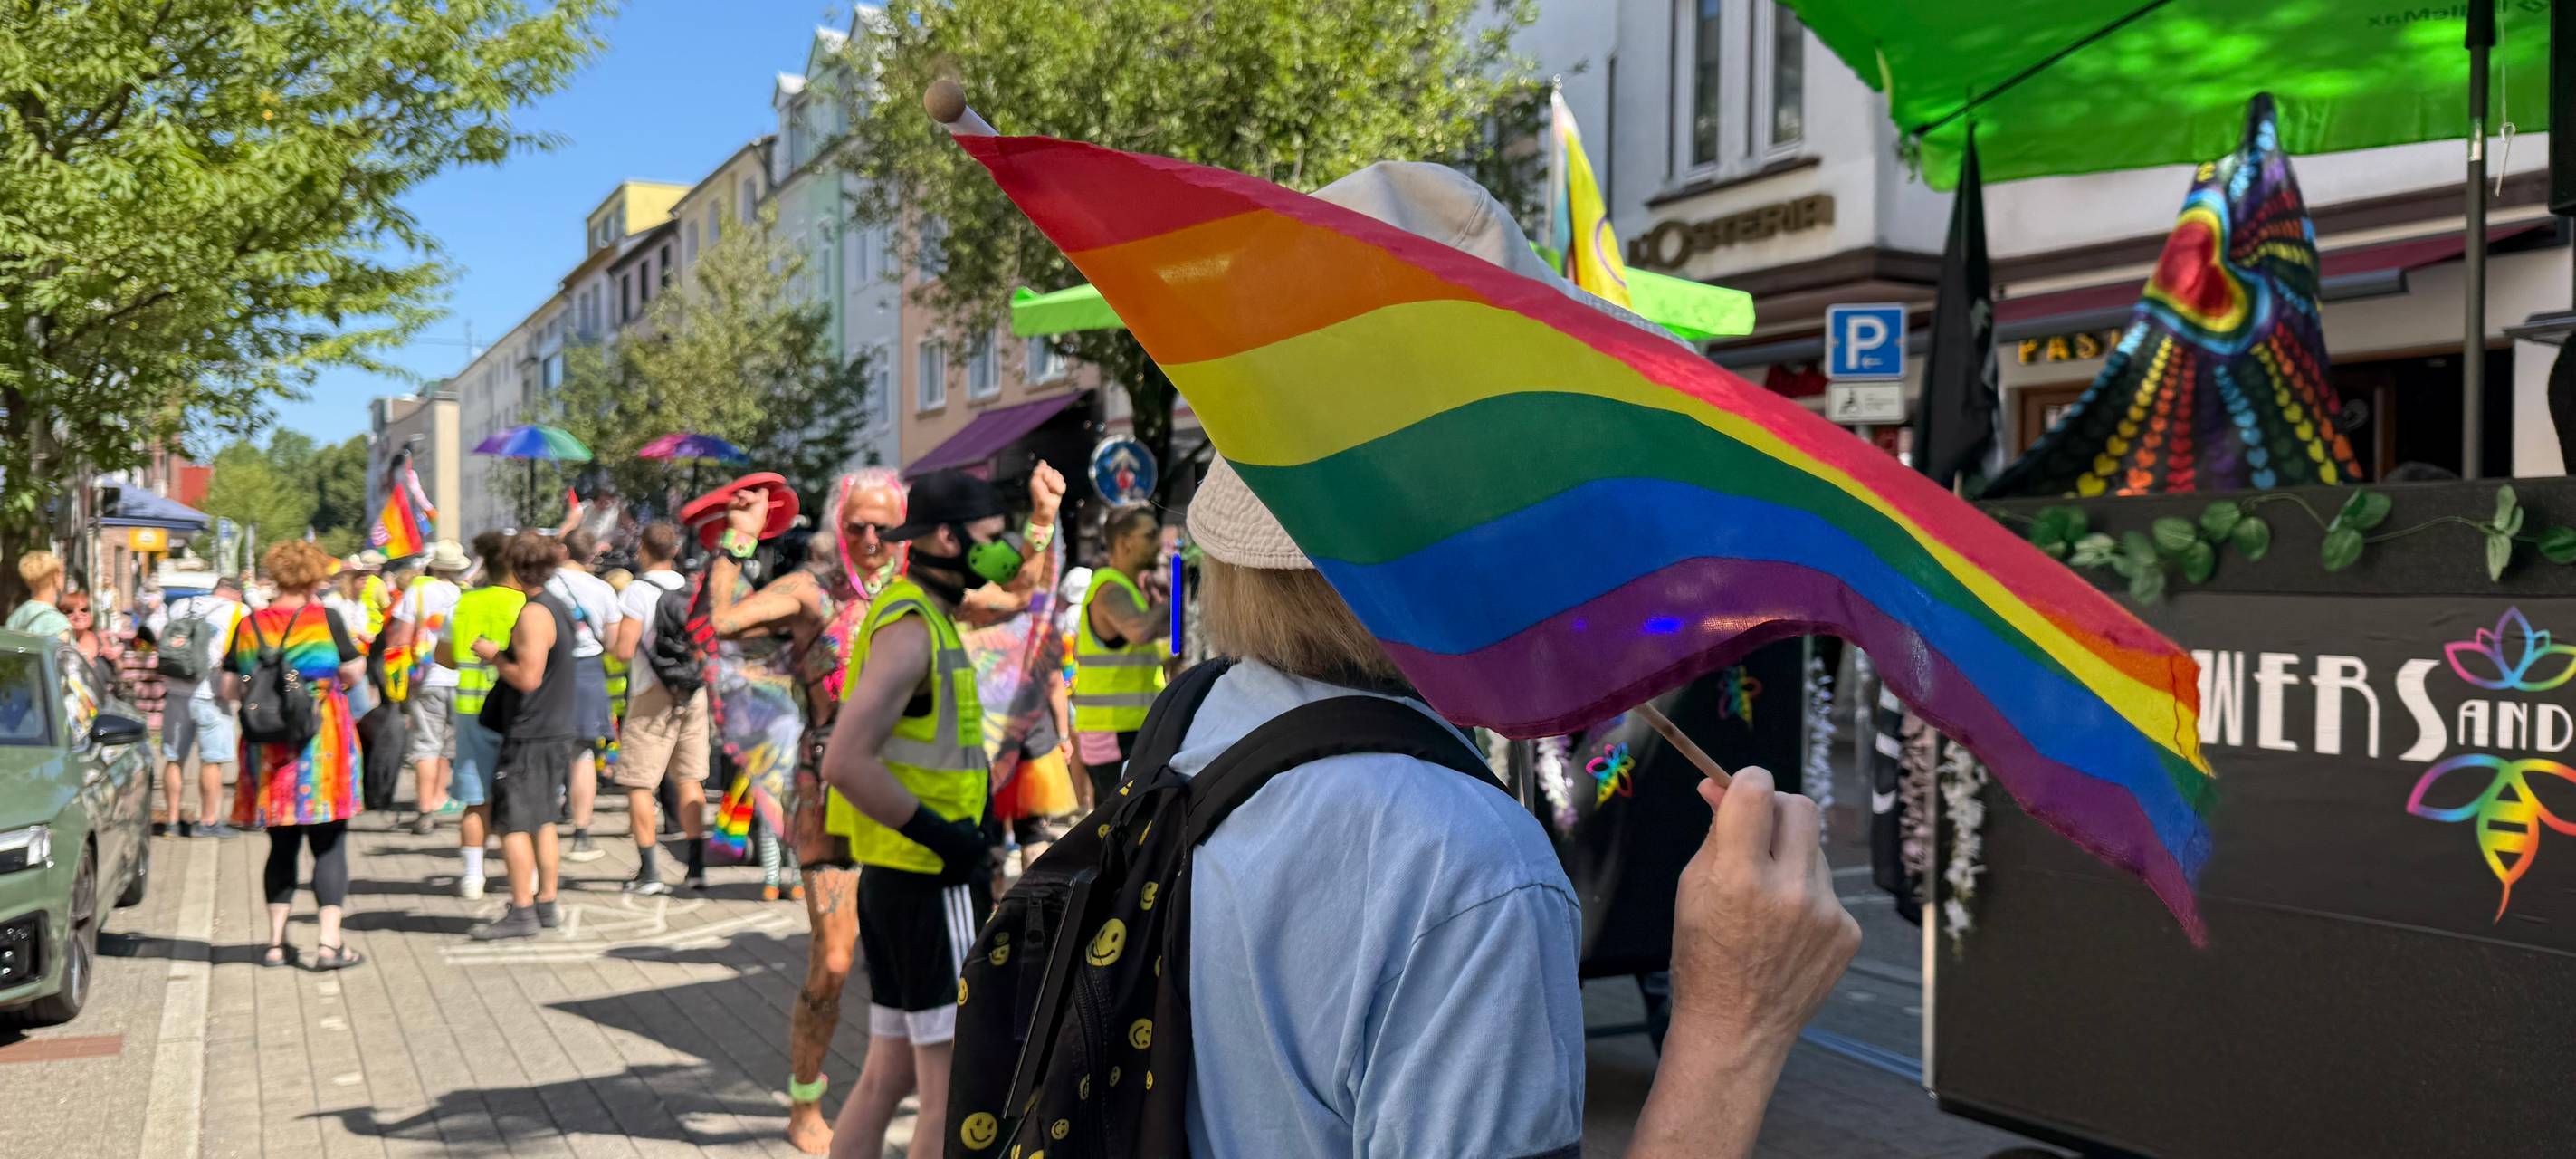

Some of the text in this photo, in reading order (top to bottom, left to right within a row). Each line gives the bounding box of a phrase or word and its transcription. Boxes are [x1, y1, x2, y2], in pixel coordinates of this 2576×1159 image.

[1846, 315, 1888, 369] P
[2191, 649, 2573, 762] WERS AND
